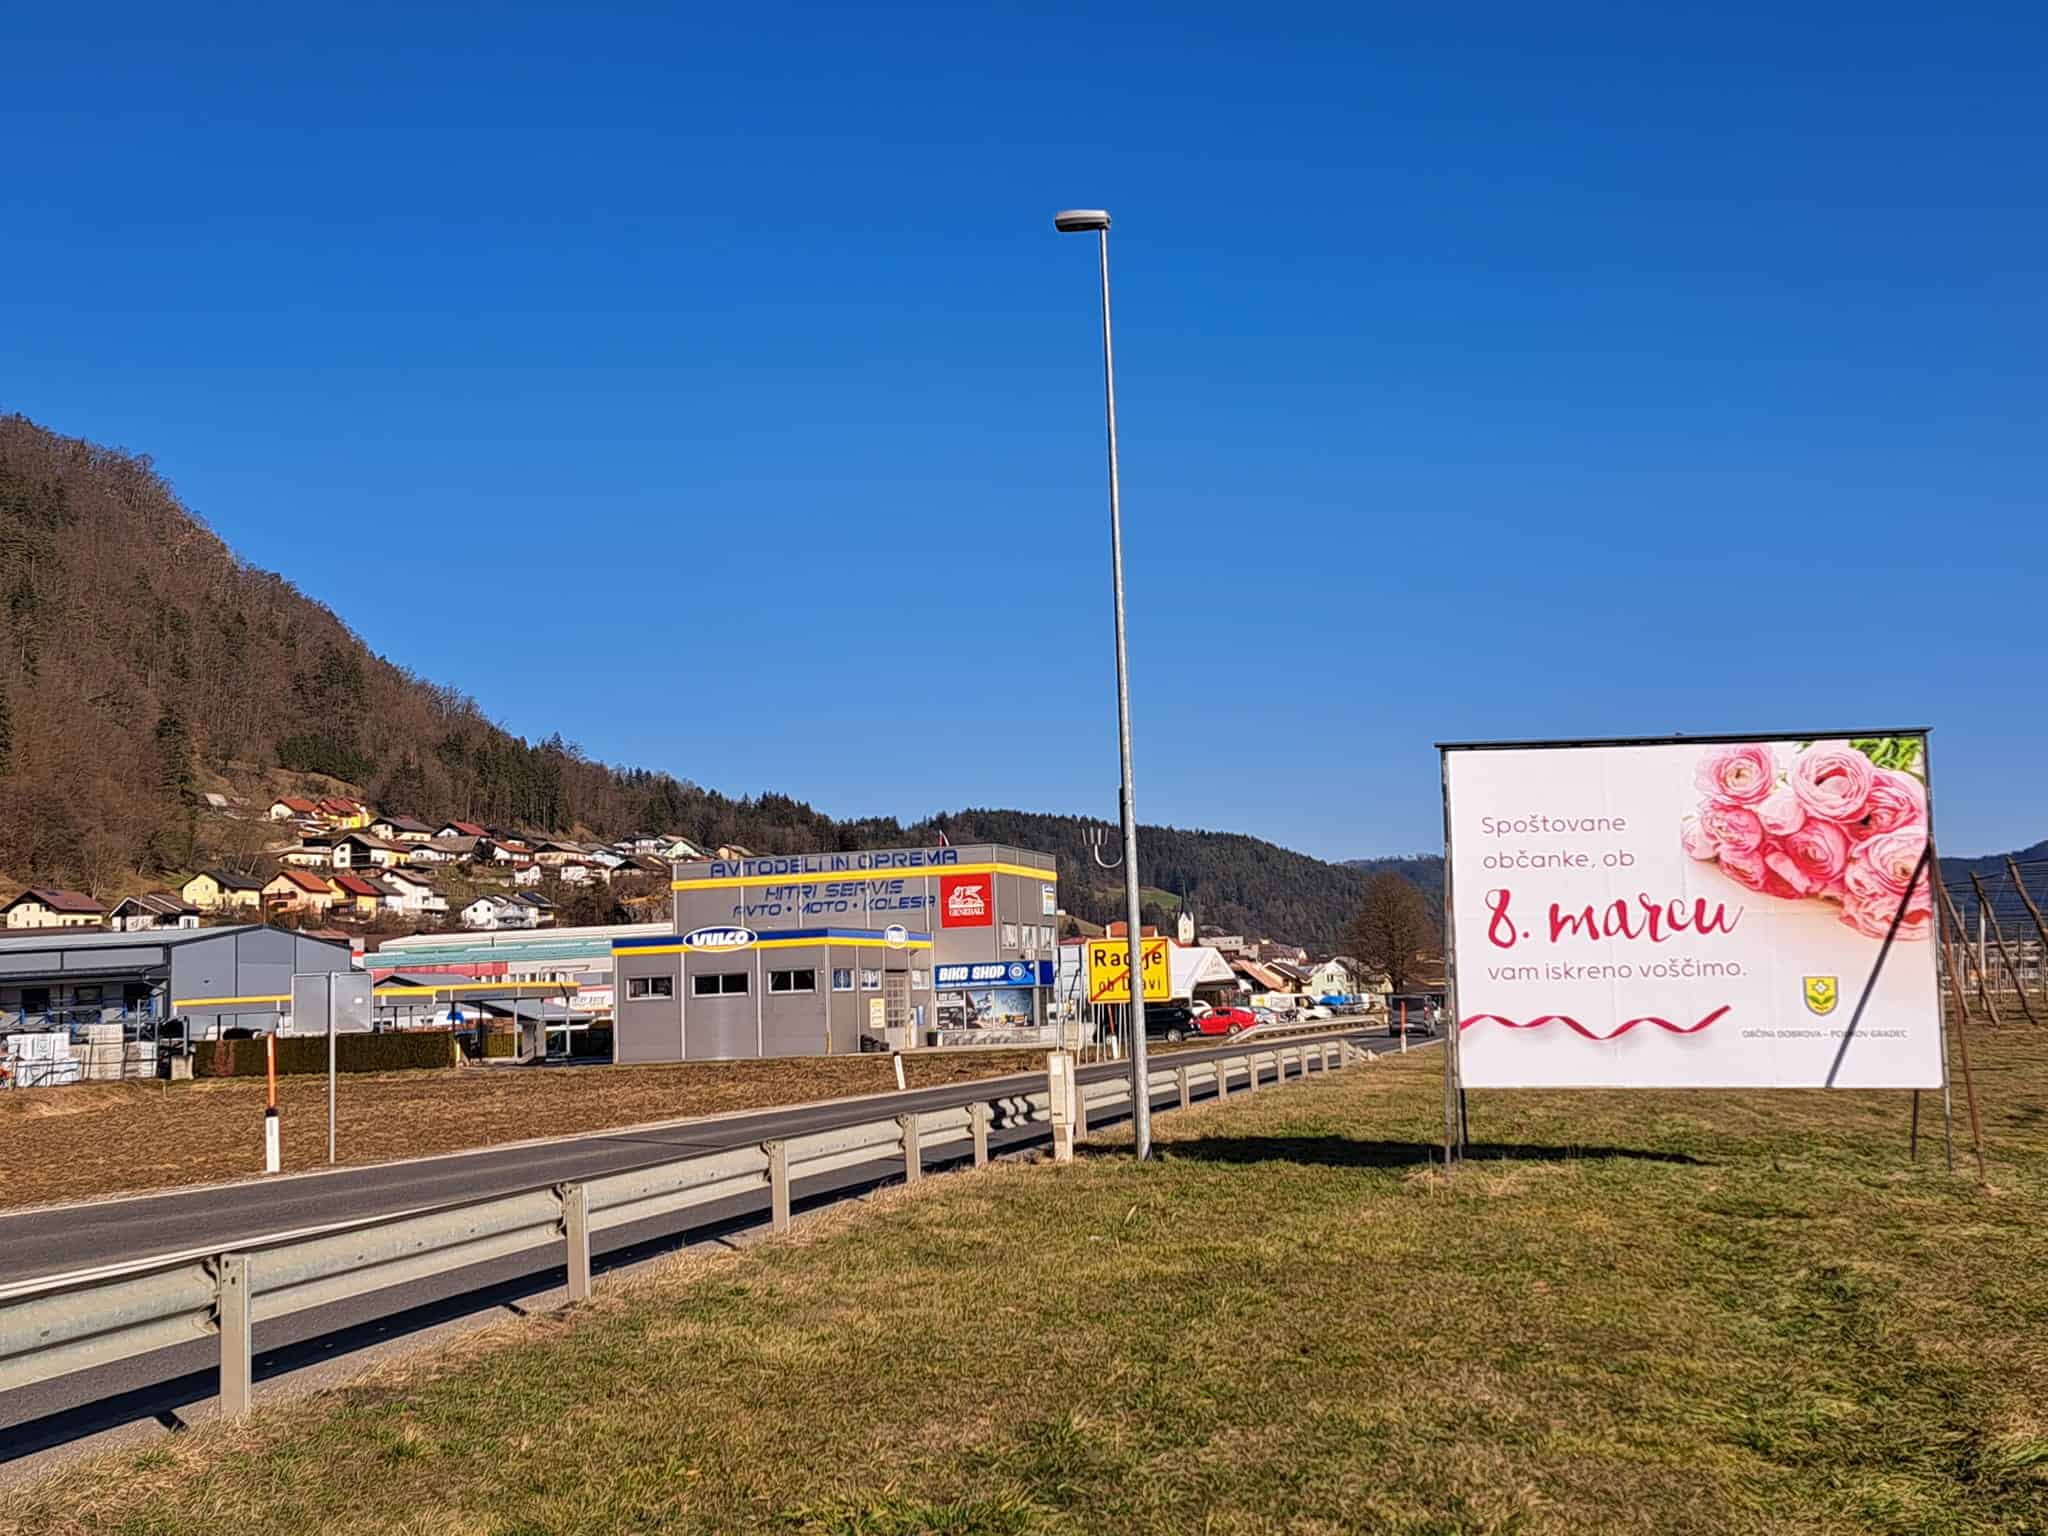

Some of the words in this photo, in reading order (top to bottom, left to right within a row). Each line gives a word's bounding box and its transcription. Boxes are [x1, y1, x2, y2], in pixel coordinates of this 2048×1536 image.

[1481, 814, 1627, 838] Spoštovane
[710, 857, 823, 878] AVTODELI
[830, 854, 850, 873] IN
[858, 849, 959, 871] OPREMA
[1482, 850, 1597, 870] občanke,
[1602, 849, 1635, 867] ob
[764, 884, 817, 901] HITRI
[824, 879, 905, 898] SERVIS
[732, 903, 782, 918] AVTO
[862, 895, 937, 911] KOLESA
[1484, 888, 1530, 949] 8.
[1549, 892, 1745, 943] marcu
[1094, 947, 1162, 970] Raje
[1487, 965, 1539, 981] vam
[1545, 961, 1633, 981] iskreno
[1639, 957, 1748, 979] voščimo.
[971, 964, 1006, 980] SHOP
[1122, 976, 1161, 991] Dvi
[1830, 1029, 1869, 1038] POOV
